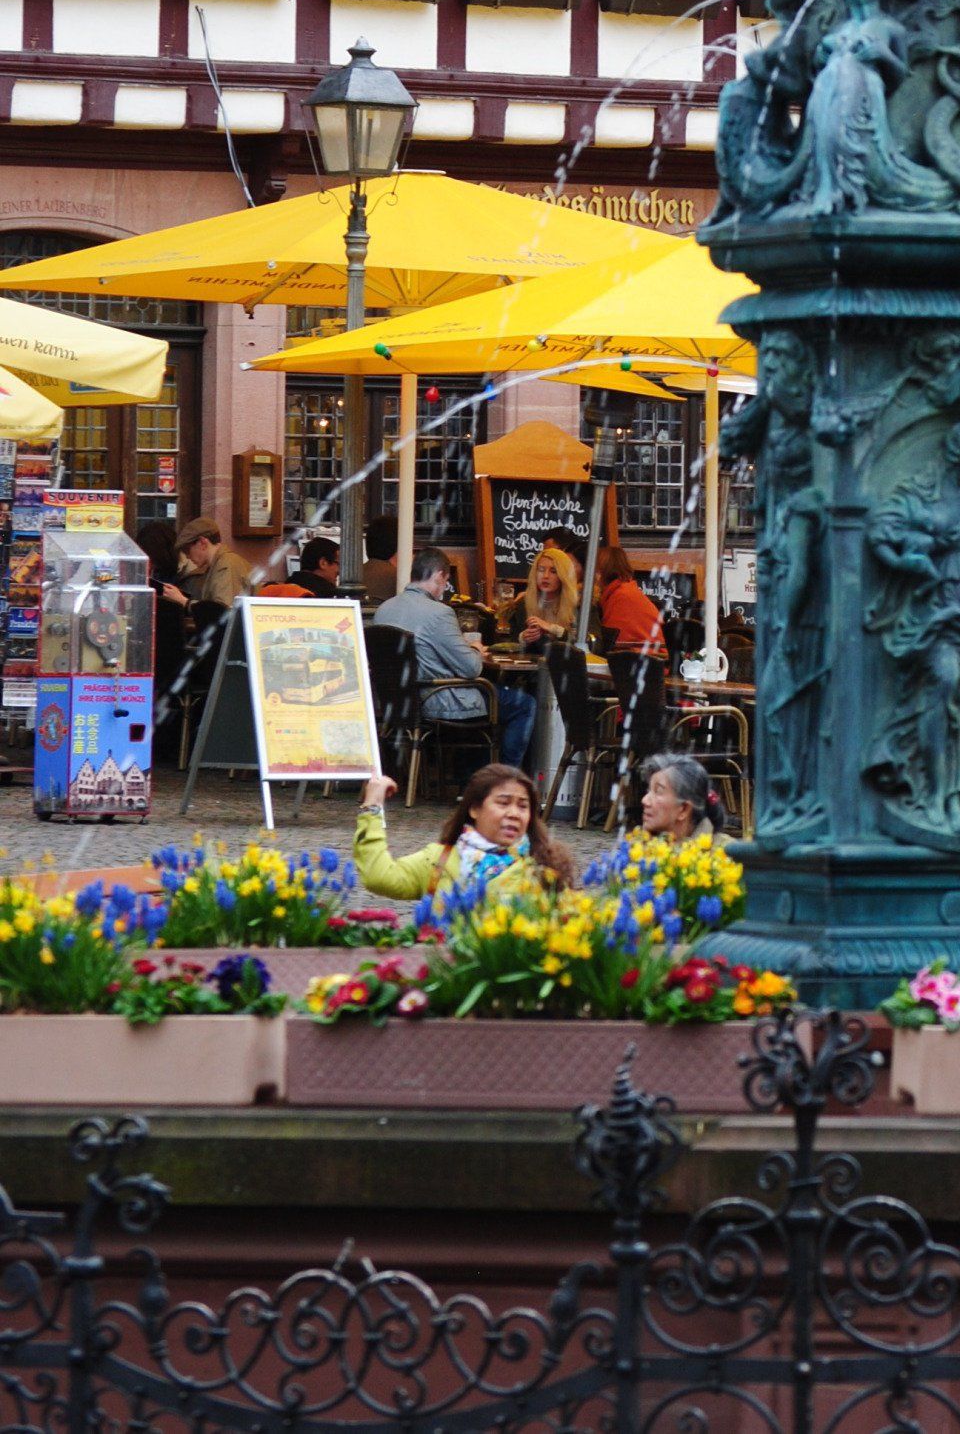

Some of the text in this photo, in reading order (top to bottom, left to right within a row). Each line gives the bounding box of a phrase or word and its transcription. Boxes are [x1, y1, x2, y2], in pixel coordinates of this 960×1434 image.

[34, 339, 79, 361] kann.
[49, 492, 120, 503] SOUVENIR
[501, 489, 585, 520] Ofenfrische
